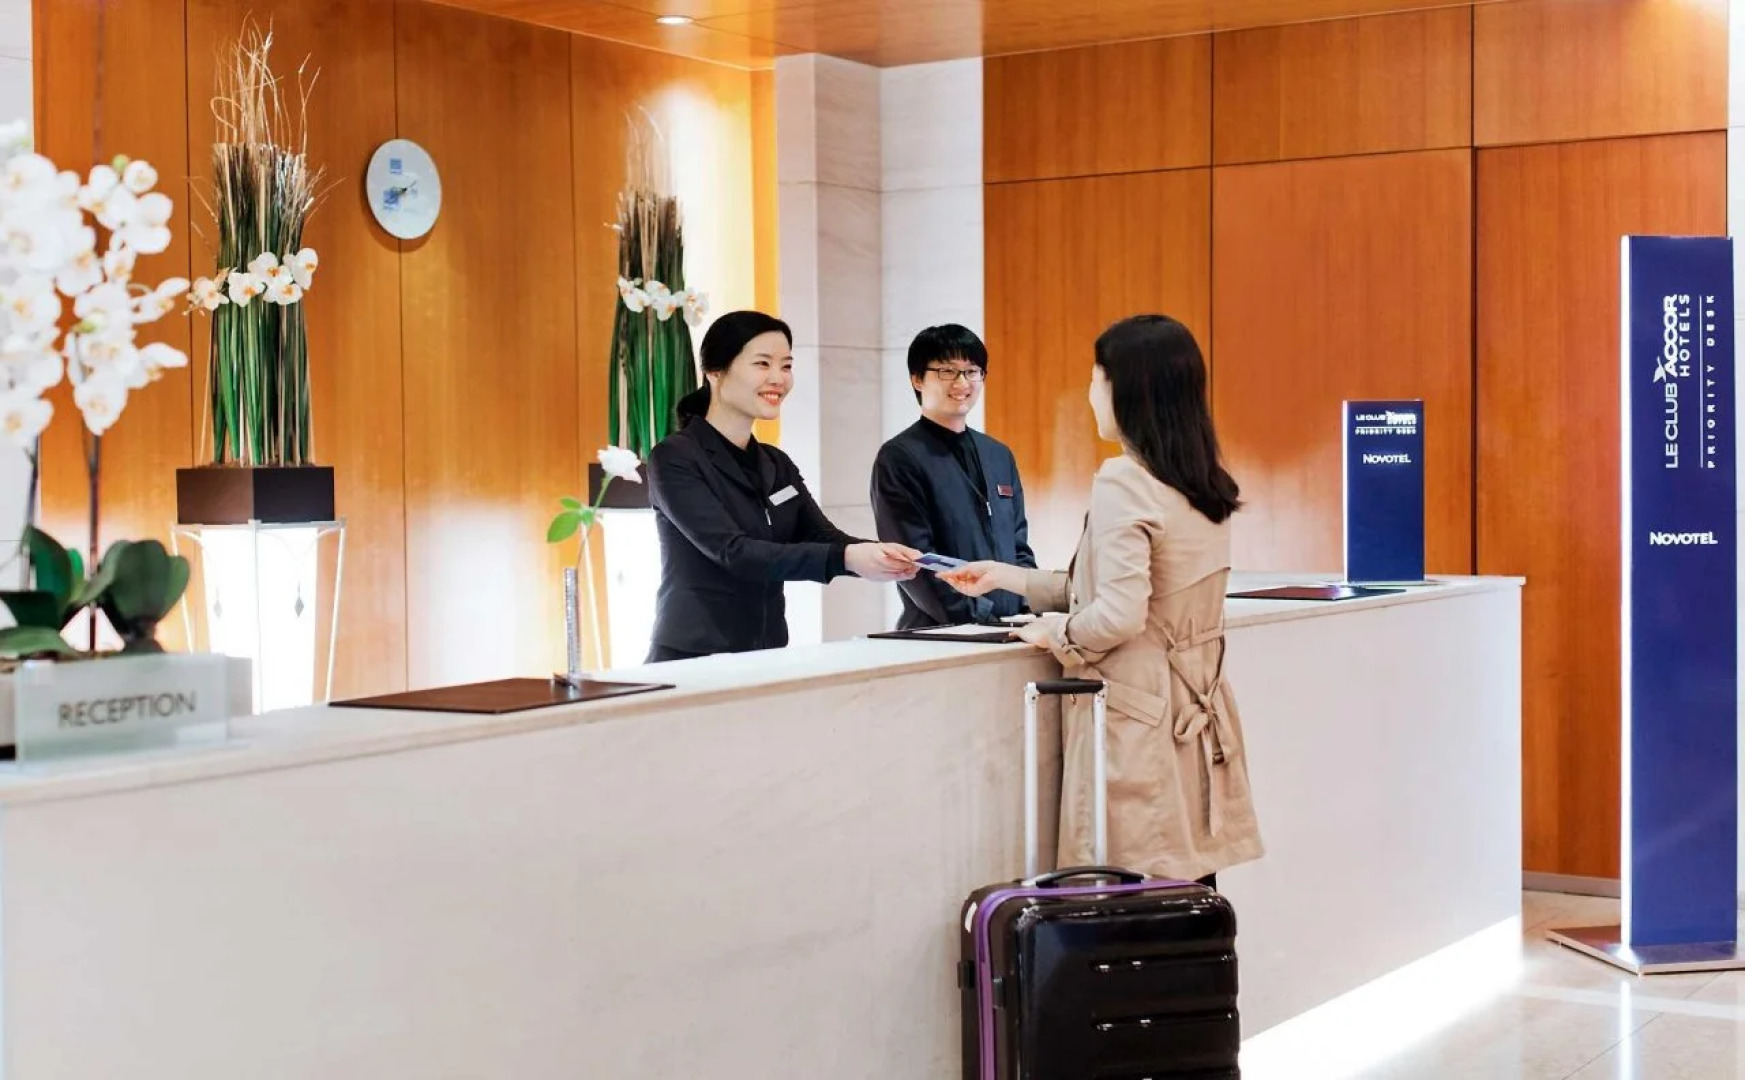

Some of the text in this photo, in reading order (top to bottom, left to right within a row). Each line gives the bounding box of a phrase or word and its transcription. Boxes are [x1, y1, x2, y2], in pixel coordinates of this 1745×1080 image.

[1679, 294, 1690, 377] HOTELS
[1663, 294, 1678, 468] LE CLUB ACCOR
[1706, 365, 1715, 468] PRIORITY
[1363, 453, 1411, 464] NOVOTEL
[1649, 531, 1718, 545] NOVOTEL
[58, 690, 197, 728] RECEPTION
